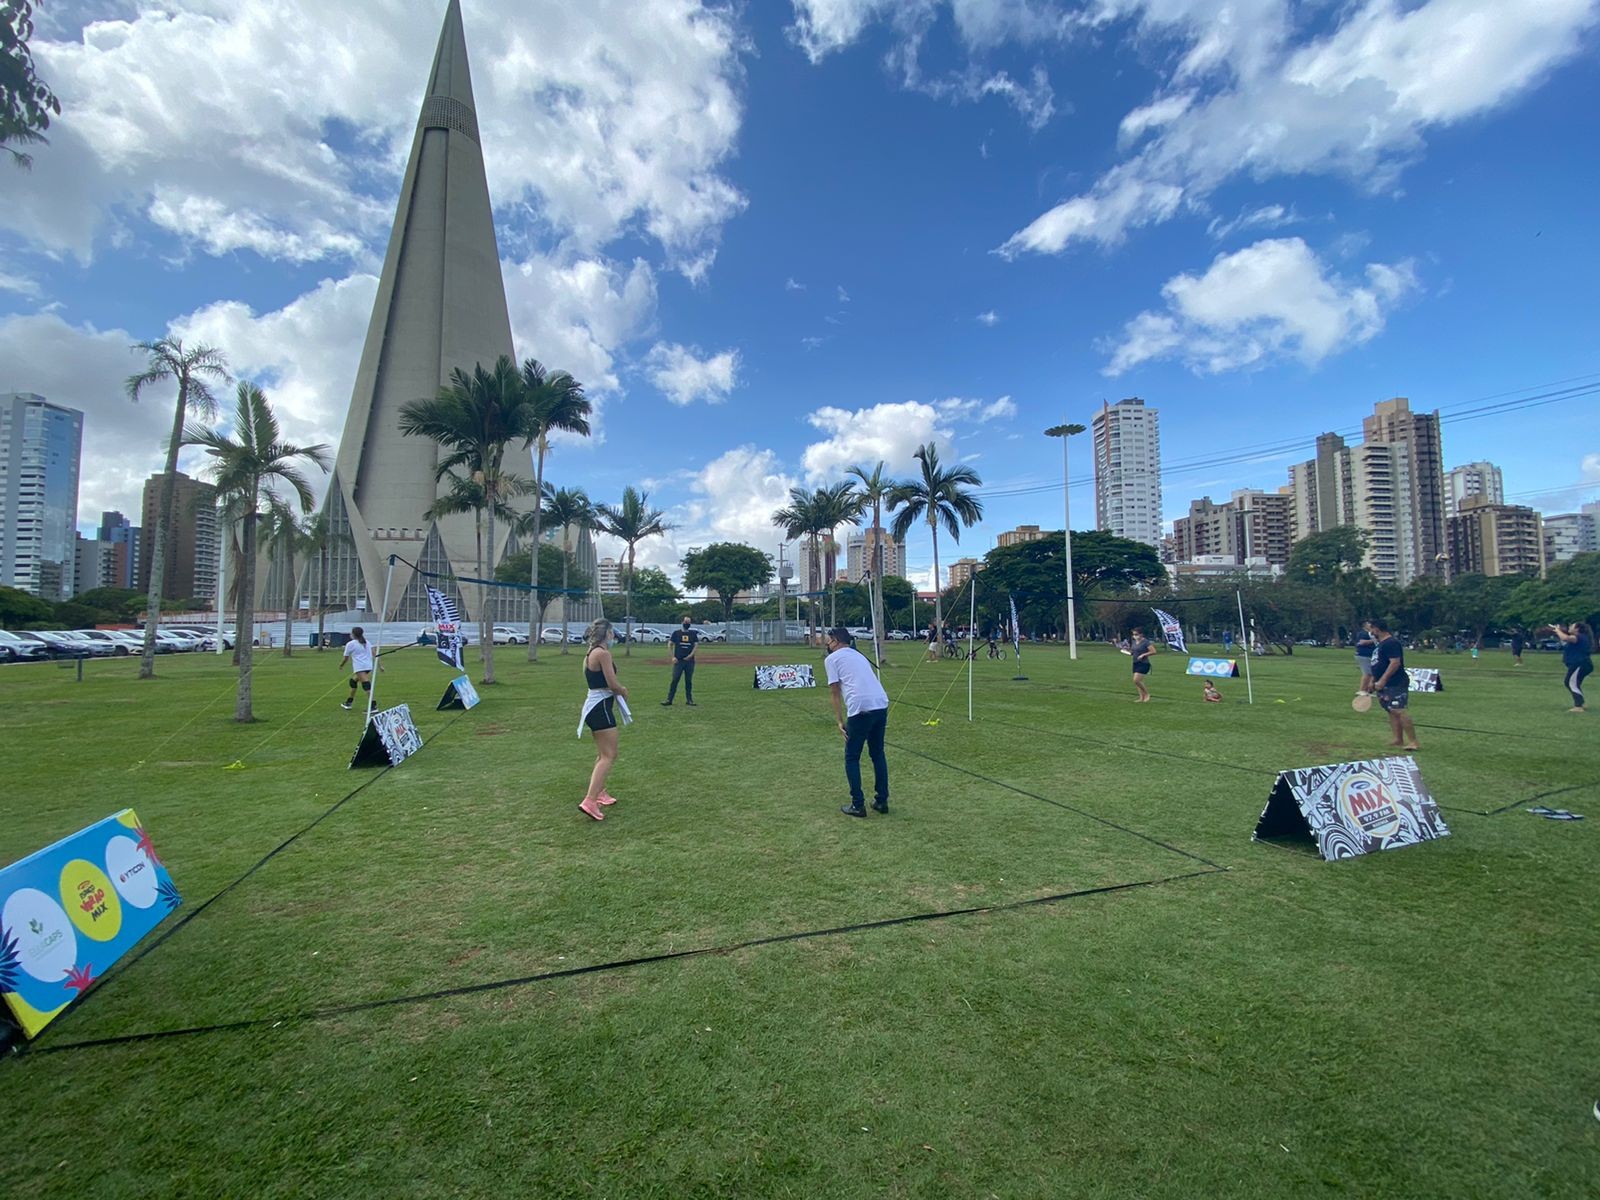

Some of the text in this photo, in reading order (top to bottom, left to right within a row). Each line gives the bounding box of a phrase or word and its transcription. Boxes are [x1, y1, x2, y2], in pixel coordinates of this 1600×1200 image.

[438, 623, 455, 631] MIX
[778, 671, 796, 679] MIX
[1348, 783, 1391, 816] MIX
[1363, 814, 1379, 822] 97.9
[124, 862, 145, 878] YTICON
[91, 902, 108, 922] MIX
